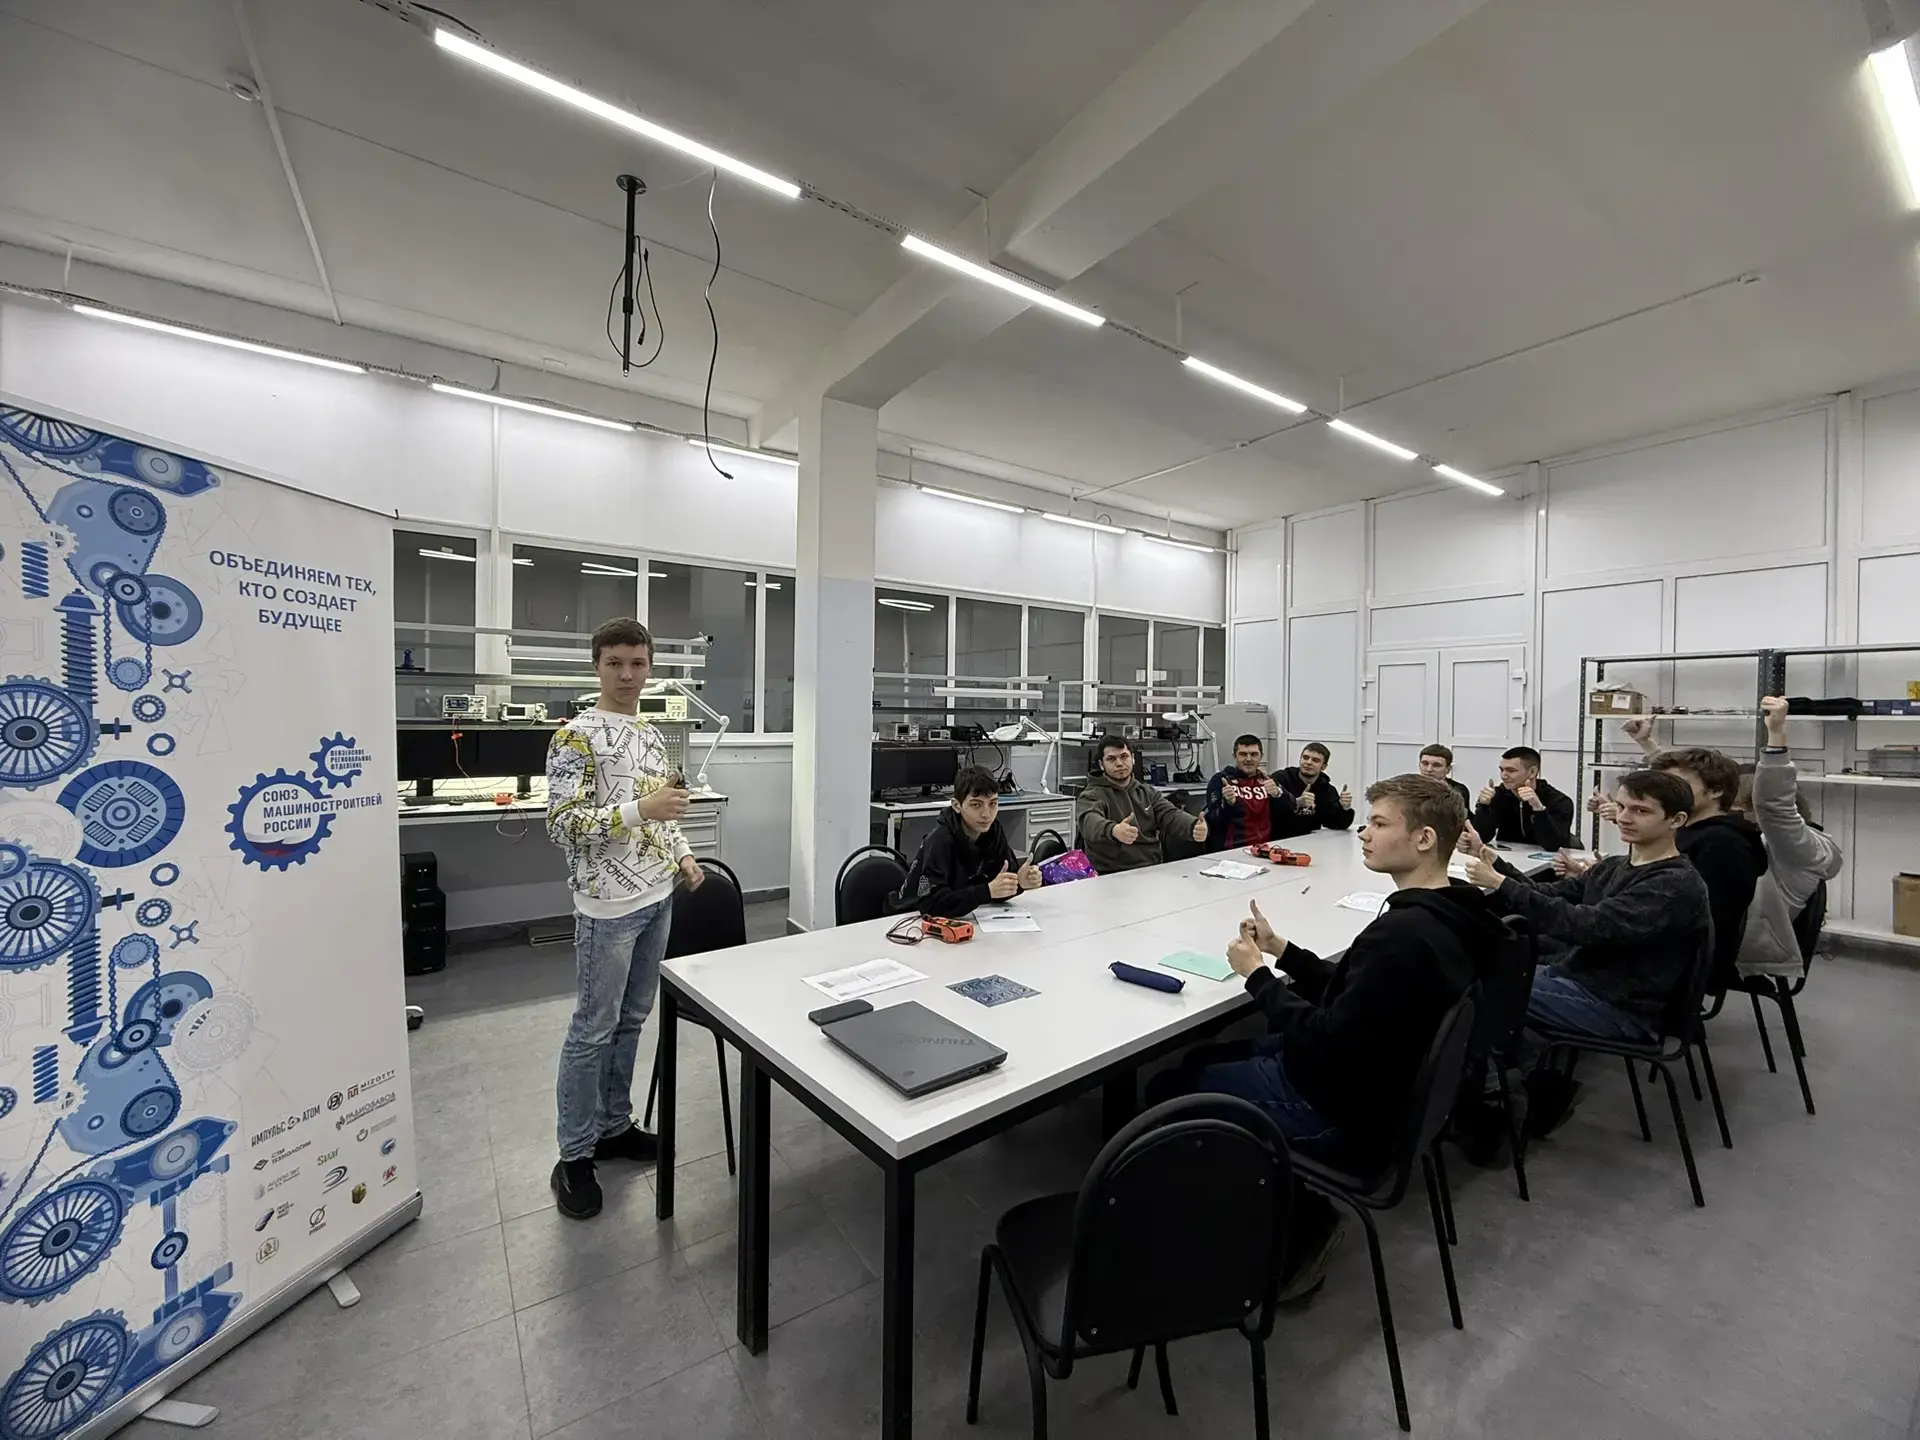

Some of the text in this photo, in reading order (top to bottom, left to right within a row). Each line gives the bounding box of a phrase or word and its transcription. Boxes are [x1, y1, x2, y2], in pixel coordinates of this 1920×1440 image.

[209, 550, 377, 596] ОБЪЕДИНЯЕМ ТЕХ,
[239, 580, 357, 612] КТО СОЗДАЕТ
[258, 608, 342, 633] БУДУЩЕЕ
[263, 788, 299, 803] СОЮЗ
[1232, 785, 1268, 800] RUSSI
[263, 793, 383, 819] МАШИНОСТРОИТЕЛЕЙ
[263, 817, 312, 834] РОССИИ
[251, 1121, 287, 1147] ИМПУЛЬС
[302, 1104, 321, 1123] АТОМ
